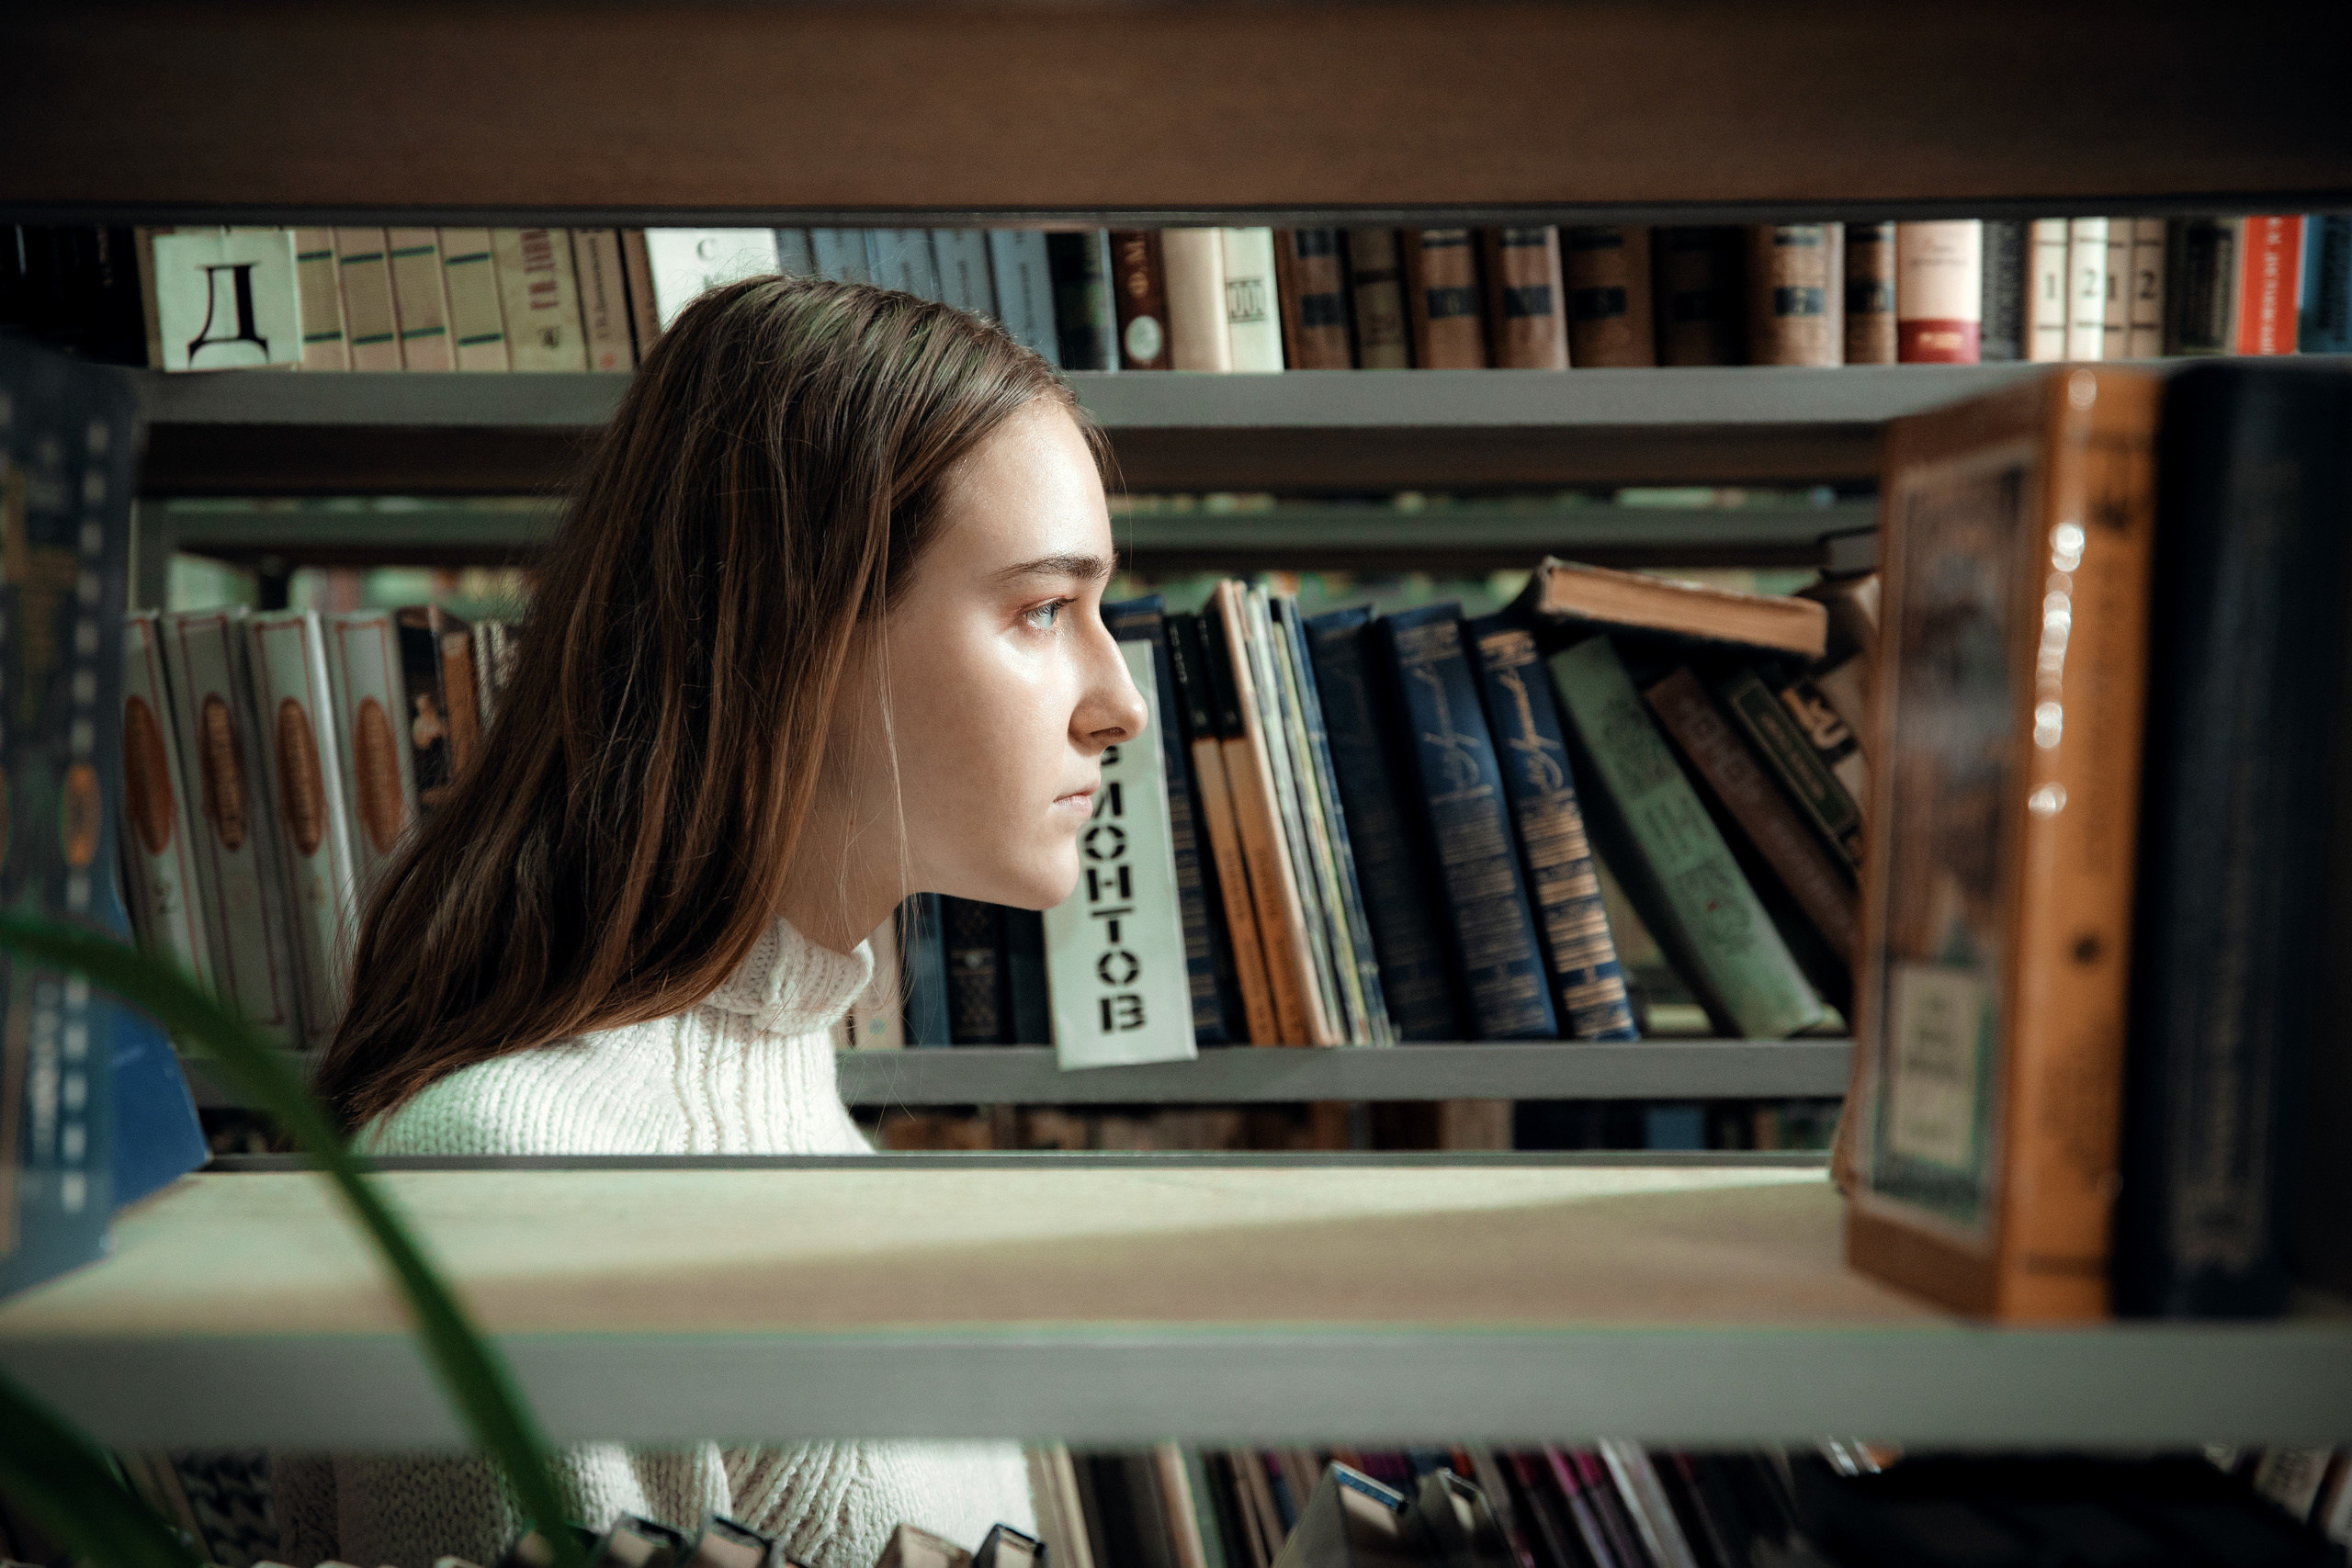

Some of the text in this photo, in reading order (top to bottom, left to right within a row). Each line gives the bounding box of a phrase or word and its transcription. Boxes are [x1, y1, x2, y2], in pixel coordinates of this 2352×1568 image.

[2082, 266, 2097, 298] 2
[2140, 268, 2158, 299] 2
[187, 260, 270, 366] Д
